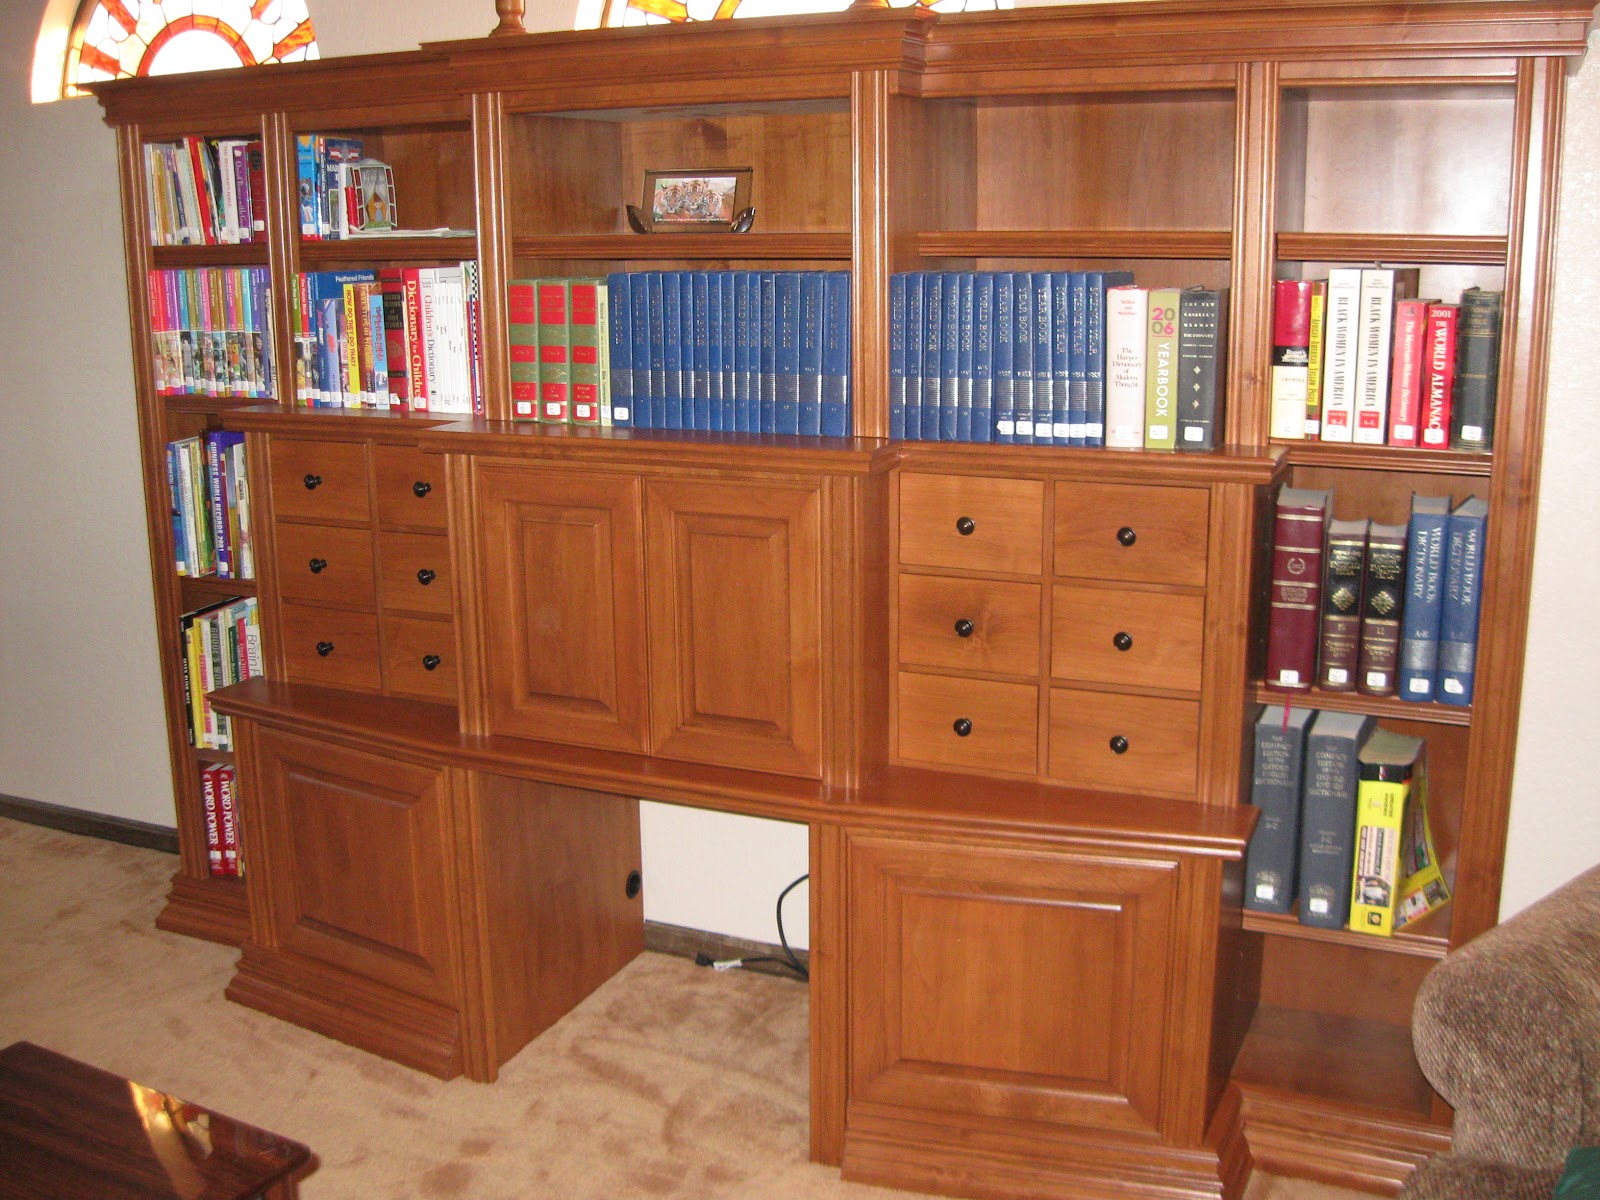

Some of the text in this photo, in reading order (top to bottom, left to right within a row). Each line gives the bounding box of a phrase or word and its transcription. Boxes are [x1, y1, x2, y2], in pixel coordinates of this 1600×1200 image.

[348, 308, 353, 317] DO
[407, 280, 417, 343] Dictionary
[412, 355, 422, 398] Childre
[424, 295, 436, 384] Children's Dictionary
[947, 286, 956, 350] WORLD BOOK
[962, 286, 970, 351] WORLD BOOK
[979, 287, 988, 351] WORLD BOOK
[999, 287, 1008, 343] YEAR BOOK
[1019, 287, 1028, 343] YEAR BOOK
[1039, 288, 1047, 344] YEAR BOOK
[1073, 287, 1083, 355] SCIENCE YEAR
[1152, 307, 1175, 321] 20
[1152, 321, 1174, 334] 06
[1337, 297, 1348, 323] BLACK
[1369, 297, 1381, 323] BLACK
[1431, 310, 1451, 318] 2001
[349, 337, 355, 346] DO
[1336, 326, 1347, 356] WOMEN
[1368, 326, 1380, 356] WOMEN
[1156, 342, 1170, 416] YEARBOOK
[1332, 371, 1345, 405] AMERICA
[1365, 372, 1377, 406] AMERICA
[1398, 321, 1414, 422] The Merriam-Webster Dictionary
[1430, 328, 1447, 430] WORLD ALMANAC
[1413, 531, 1427, 599] DICTIONARY
[1426, 528, 1441, 603] WORLD BOOK
[1449, 532, 1462, 600] DICTIONARY
[1461, 529, 1477, 605] WORLD BOOK
[247, 635, 258, 666] Brain
[204, 780, 219, 844] WORD POWER
[221, 780, 235, 844] WORD POWER
